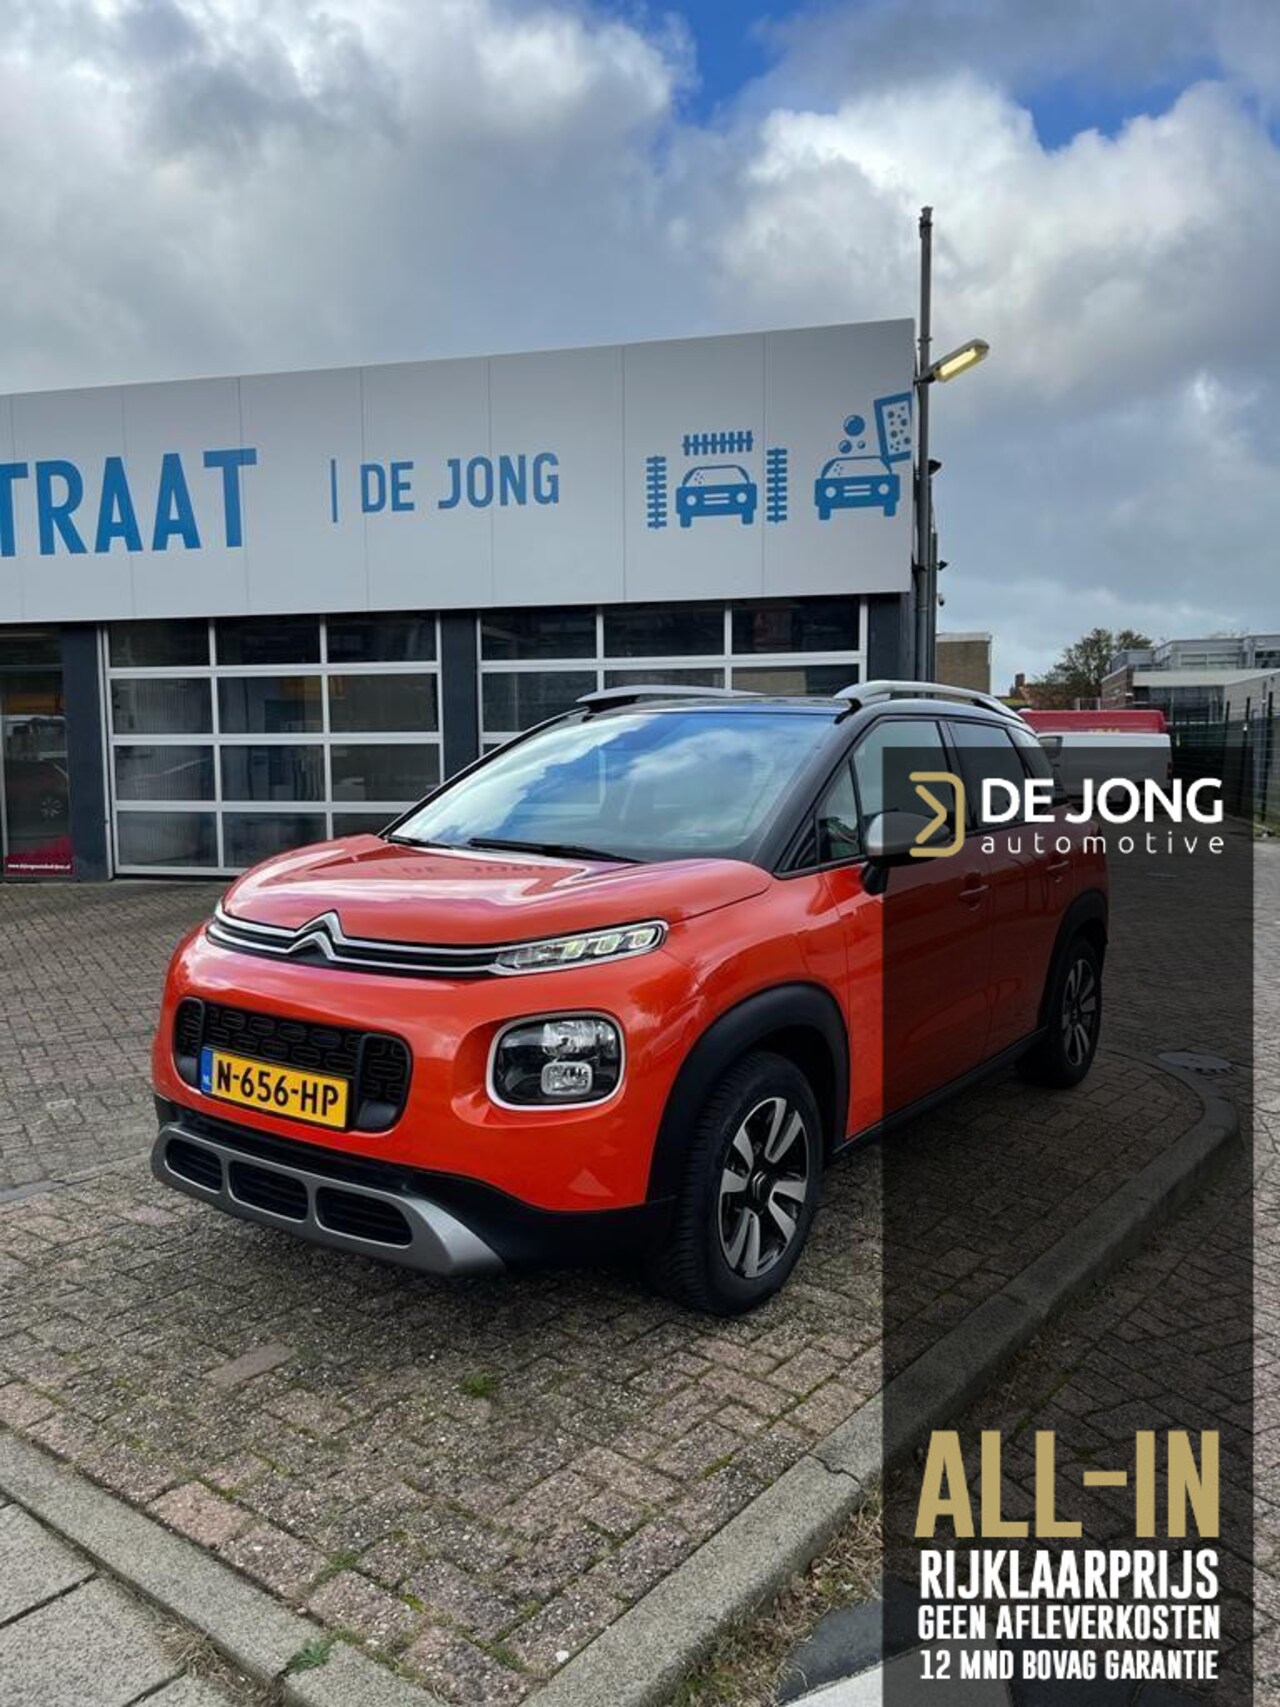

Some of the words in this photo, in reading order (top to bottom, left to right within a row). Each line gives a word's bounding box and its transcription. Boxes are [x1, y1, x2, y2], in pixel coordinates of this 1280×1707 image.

[0, 448, 257, 557] TRAAT
[360, 461, 415, 513] DE
[438, 453, 559, 509] JONG
[217, 1060, 338, 1116] N-656-HP
